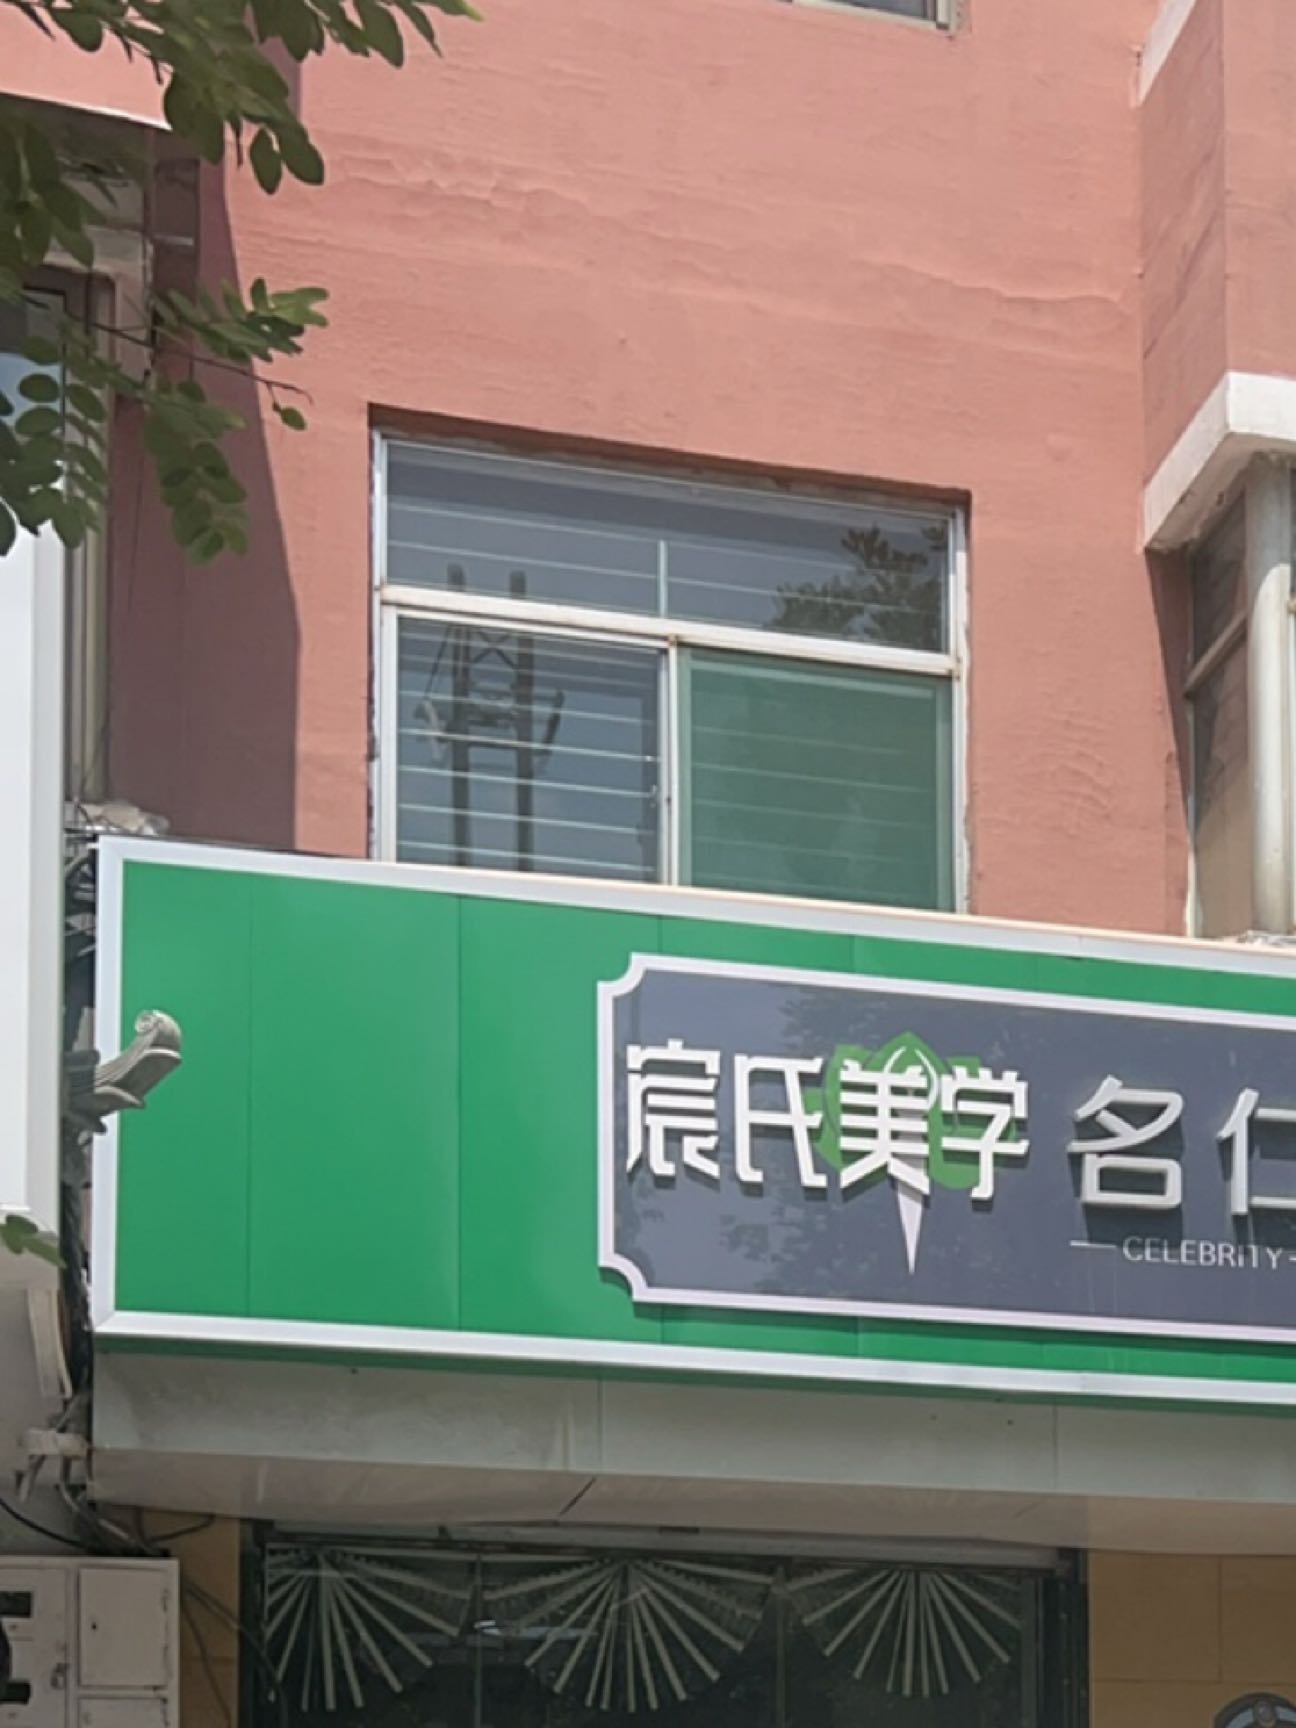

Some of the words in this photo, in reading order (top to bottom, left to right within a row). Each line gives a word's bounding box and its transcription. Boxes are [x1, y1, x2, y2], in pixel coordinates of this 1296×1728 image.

[626, 1038, 1030, 1200] 宸氏美学
[1121, 1236, 1284, 1270] CELEBRITY
